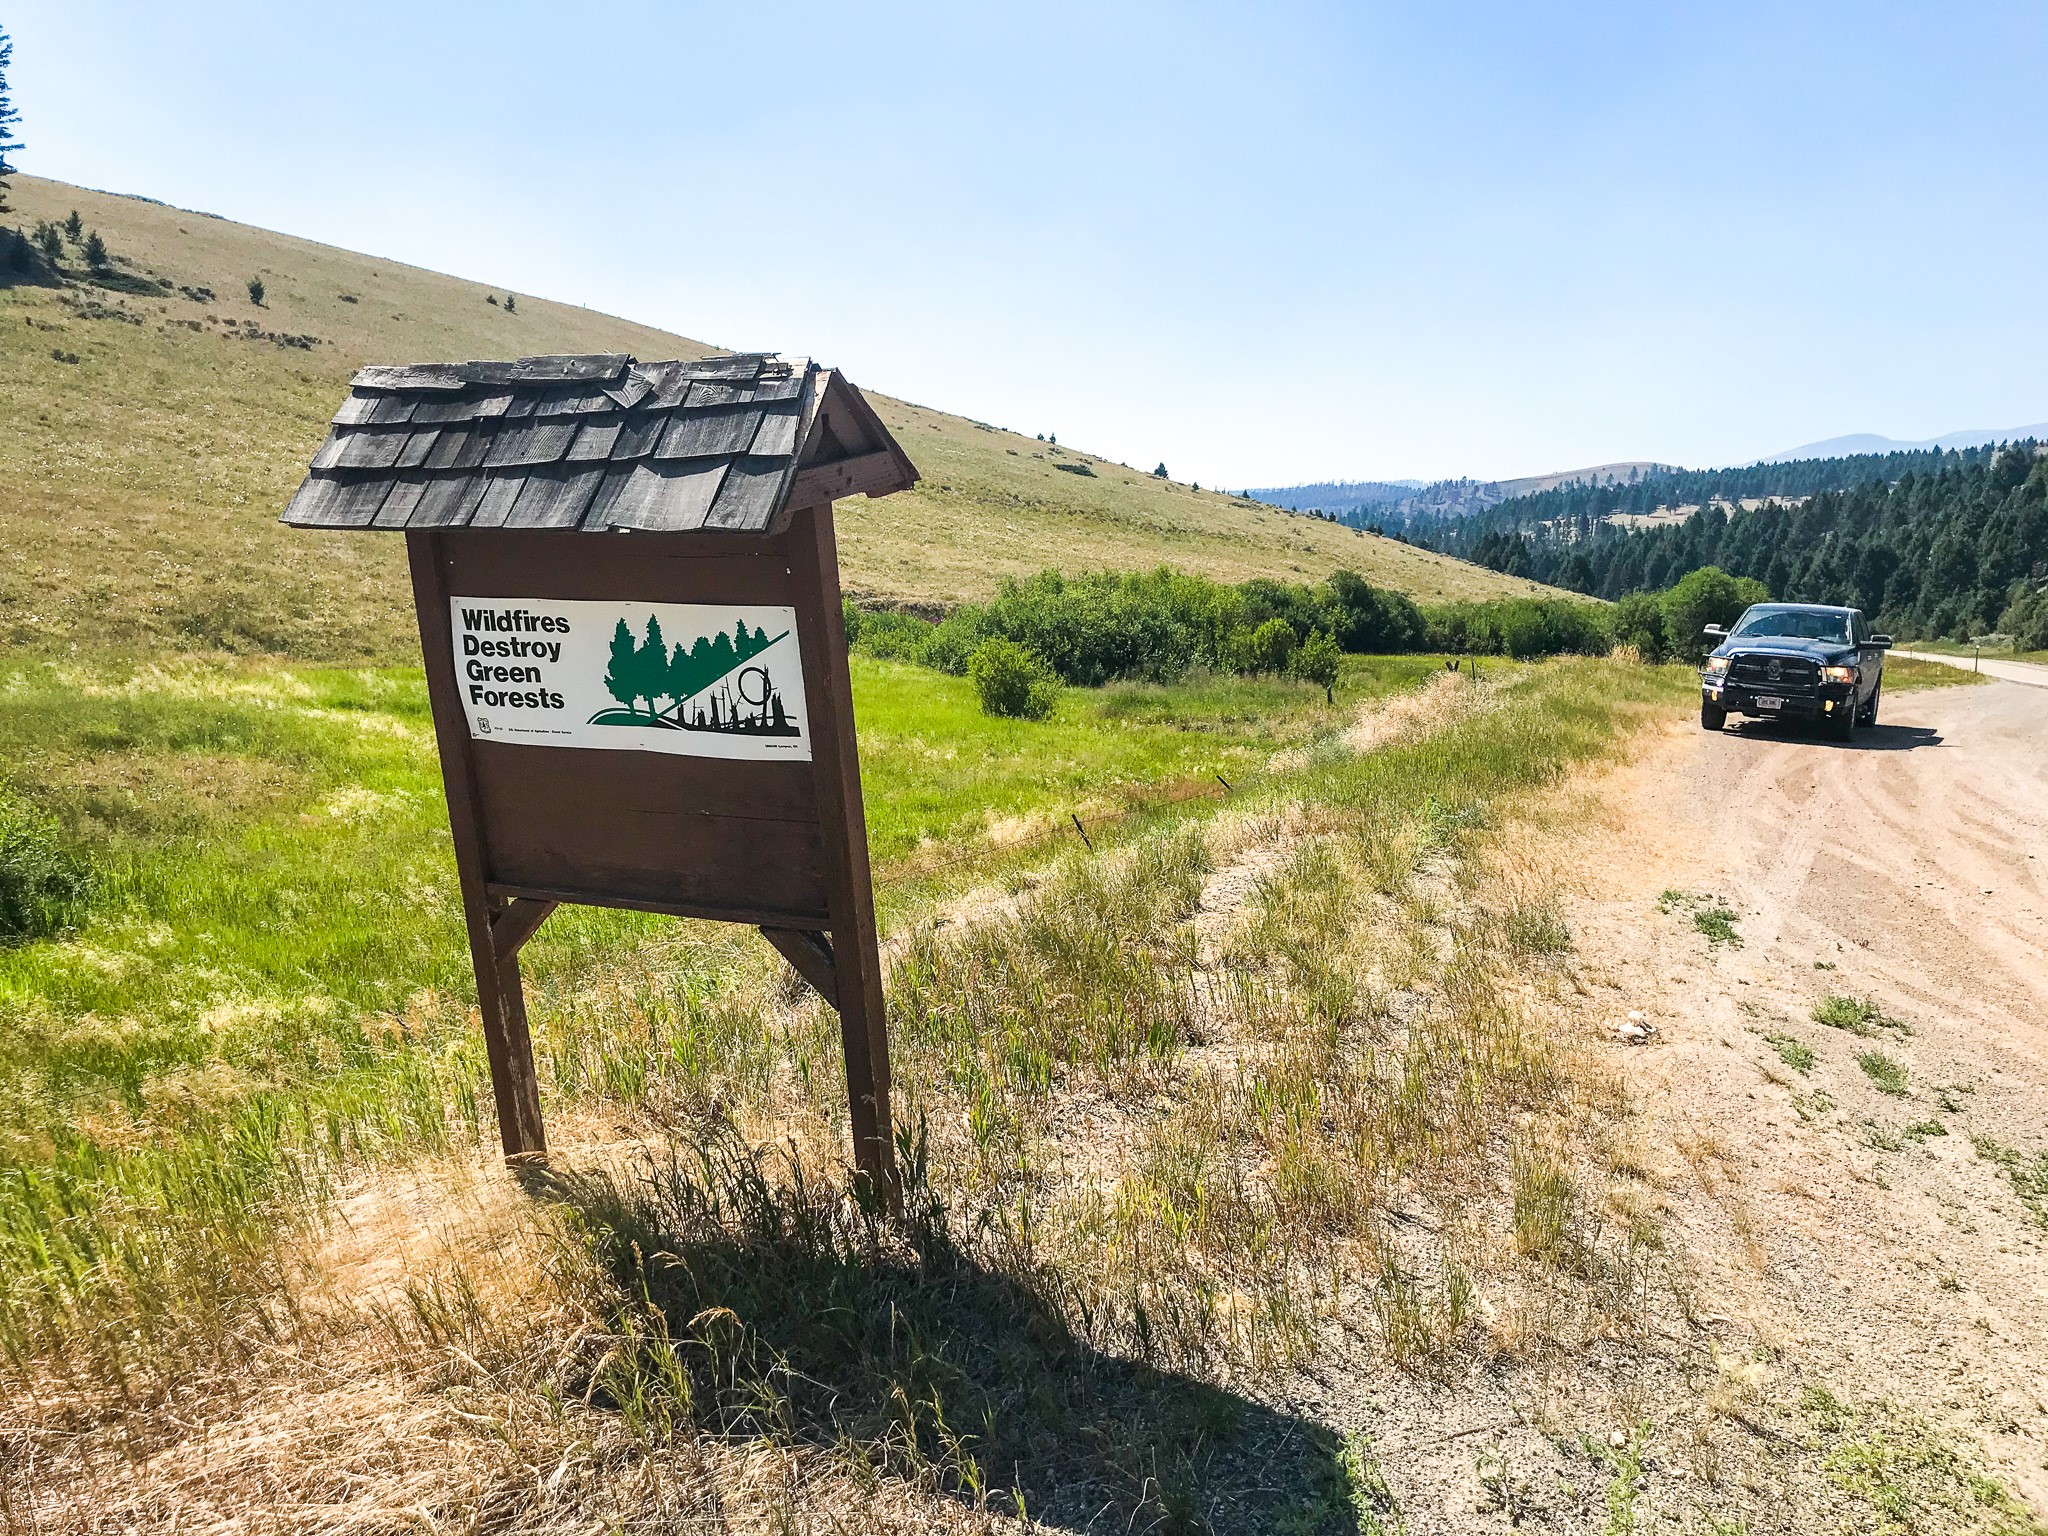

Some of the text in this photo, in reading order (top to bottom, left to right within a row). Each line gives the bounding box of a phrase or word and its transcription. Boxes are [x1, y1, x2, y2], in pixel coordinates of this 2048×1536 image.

[461, 608, 571, 633] Wildfires
[462, 634, 562, 662] Destroy
[466, 659, 542, 684] Green
[468, 684, 565, 709] Forests
